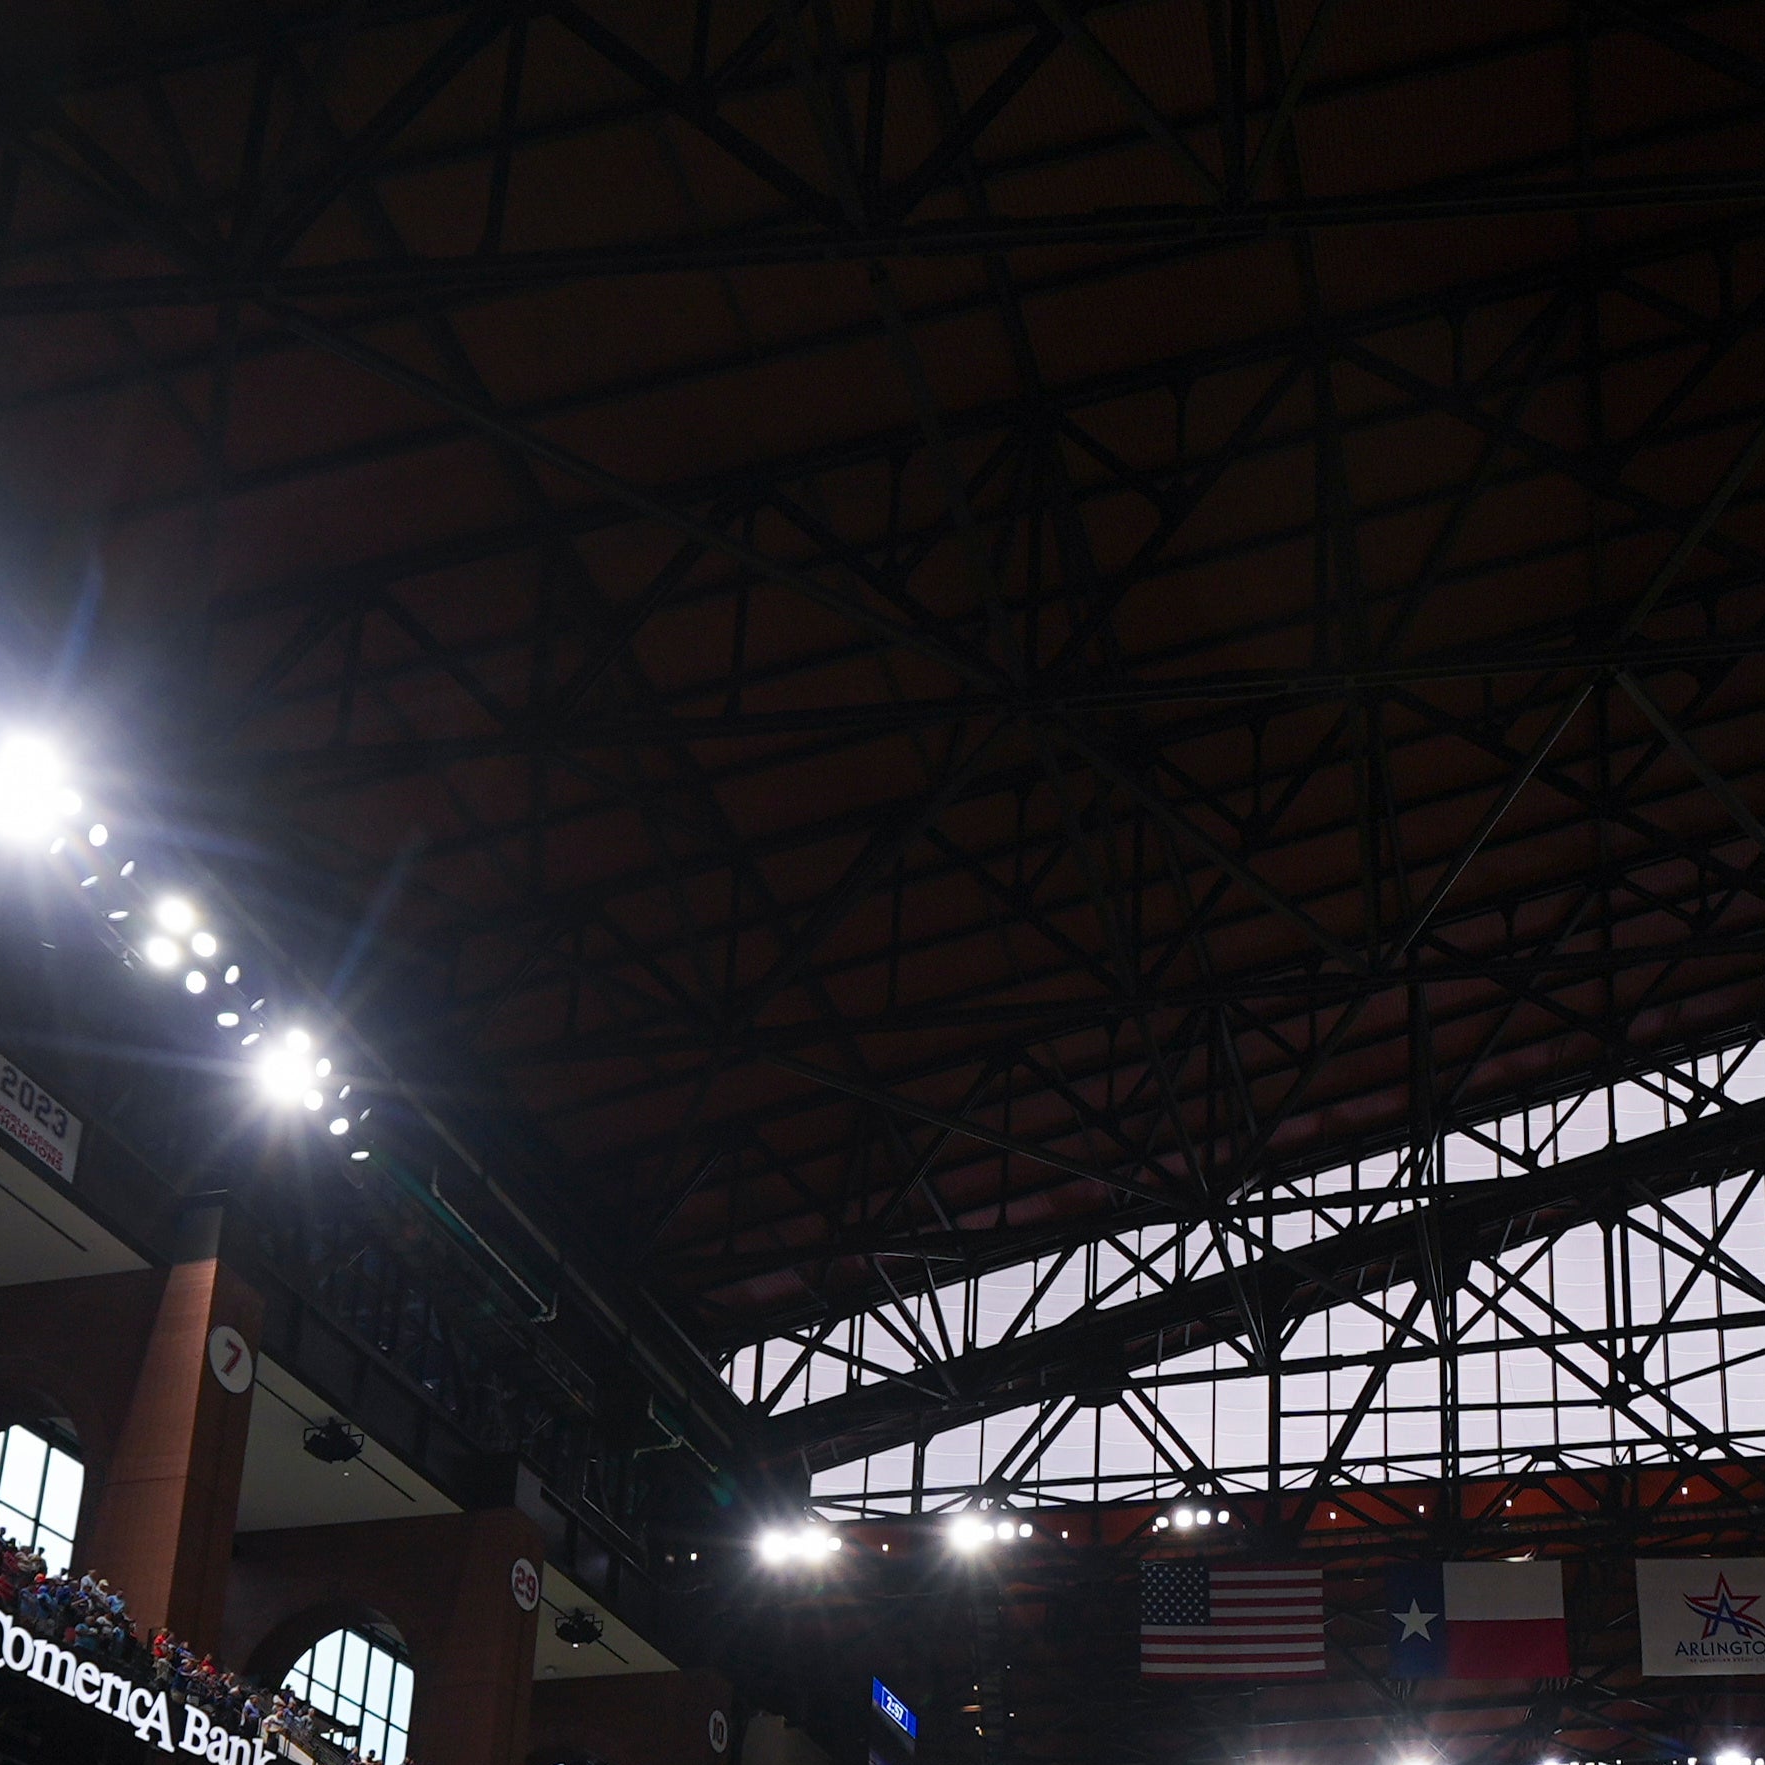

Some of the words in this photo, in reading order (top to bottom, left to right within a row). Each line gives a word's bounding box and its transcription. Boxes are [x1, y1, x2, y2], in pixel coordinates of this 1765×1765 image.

[0, 1064, 69, 1140] 2023
[512, 1565, 538, 1605] 29
[709, 1714, 727, 1748] 10
